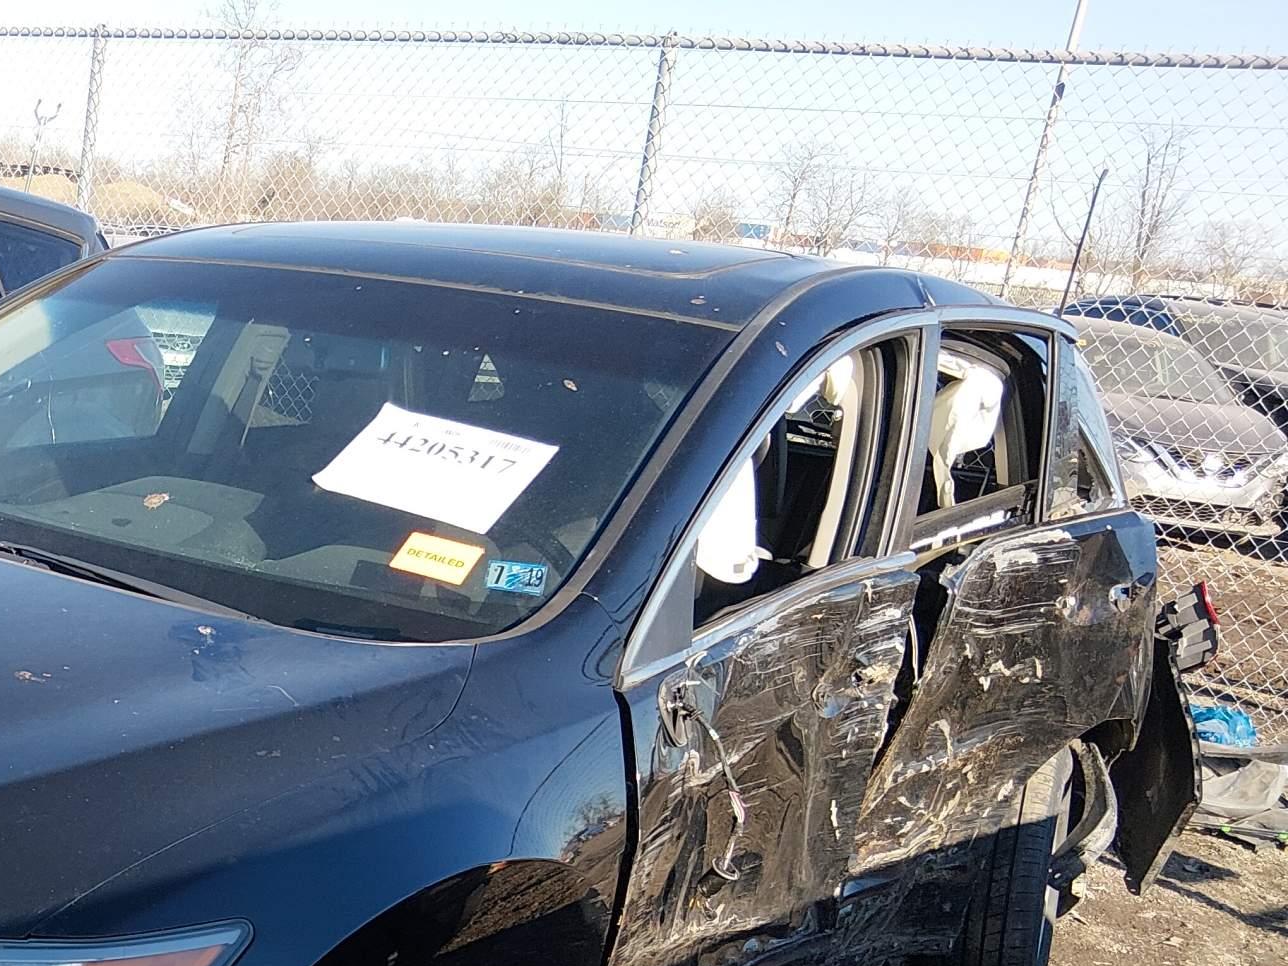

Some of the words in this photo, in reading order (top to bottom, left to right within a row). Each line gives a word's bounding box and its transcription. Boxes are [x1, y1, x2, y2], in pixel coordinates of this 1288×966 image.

[376, 431, 518, 474] 44205317
[407, 547, 465, 569] DETAILED
[494, 565, 505, 585] 7
[525, 567, 544, 588] 19
